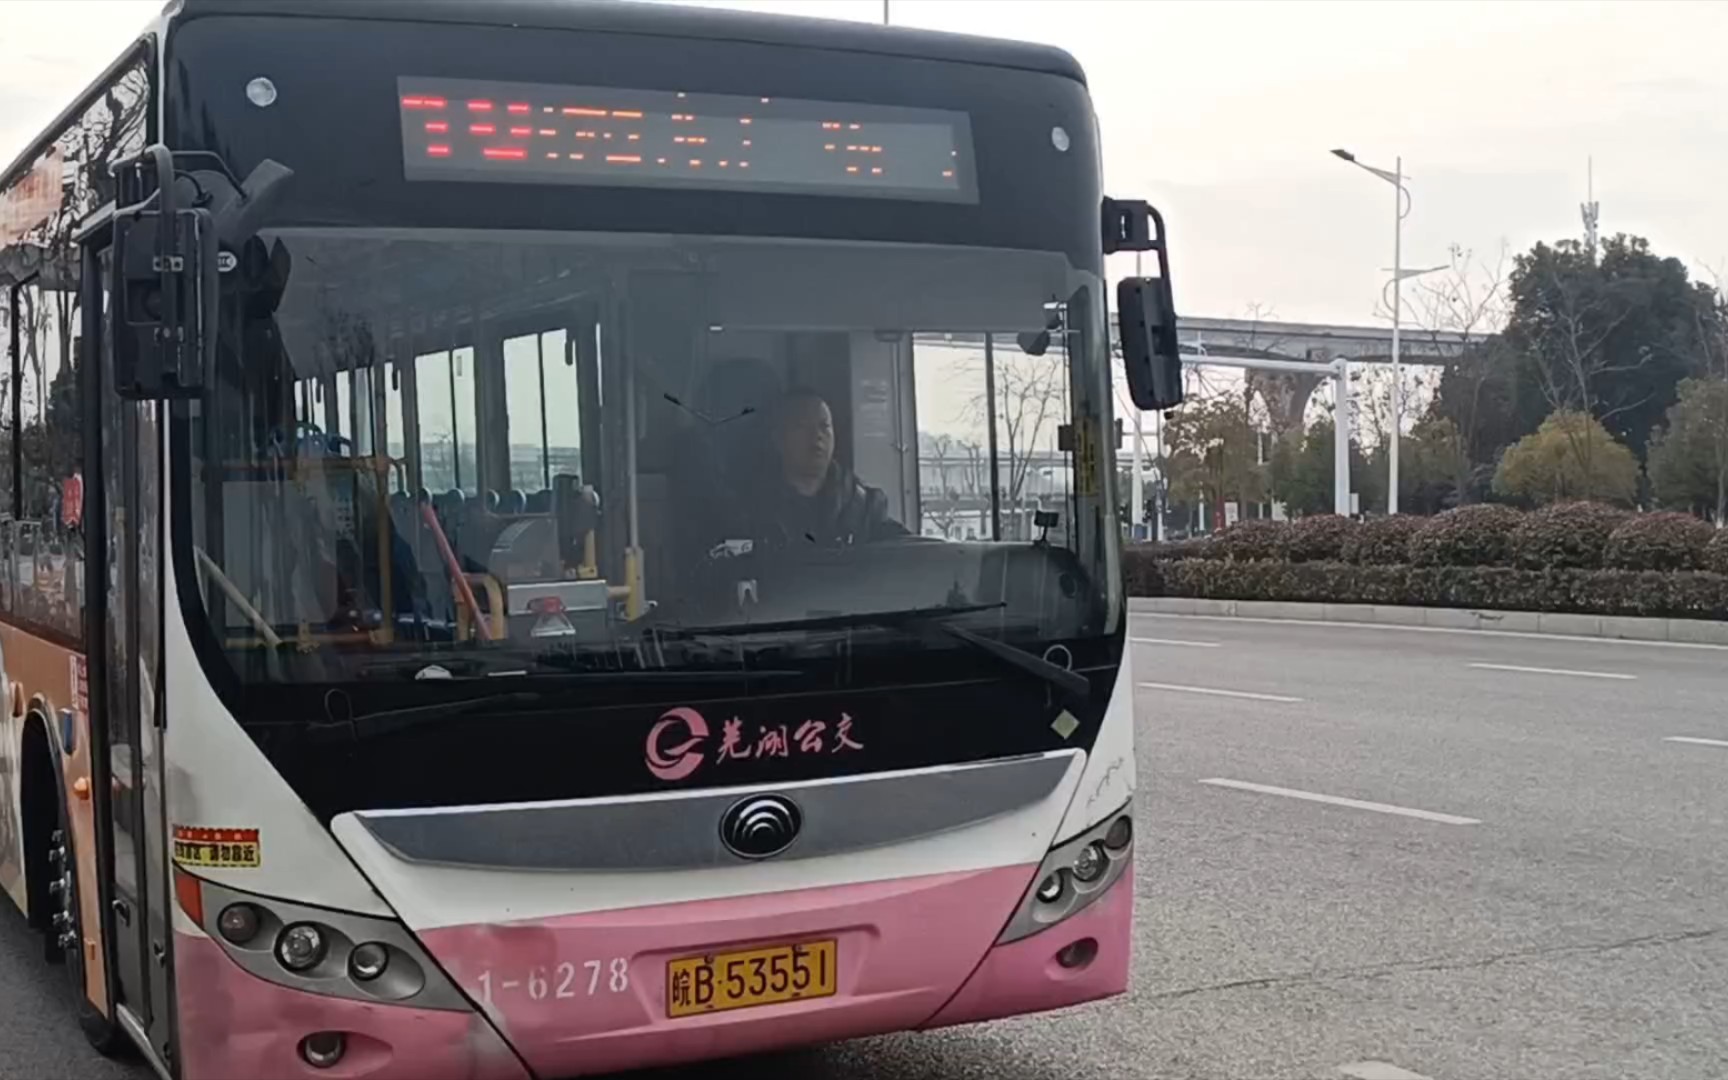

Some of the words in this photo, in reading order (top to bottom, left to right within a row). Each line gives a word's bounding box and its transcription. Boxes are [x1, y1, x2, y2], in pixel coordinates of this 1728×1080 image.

[716, 711, 864, 764] 芜湖公交
[477, 957, 630, 1004] 1-6278
